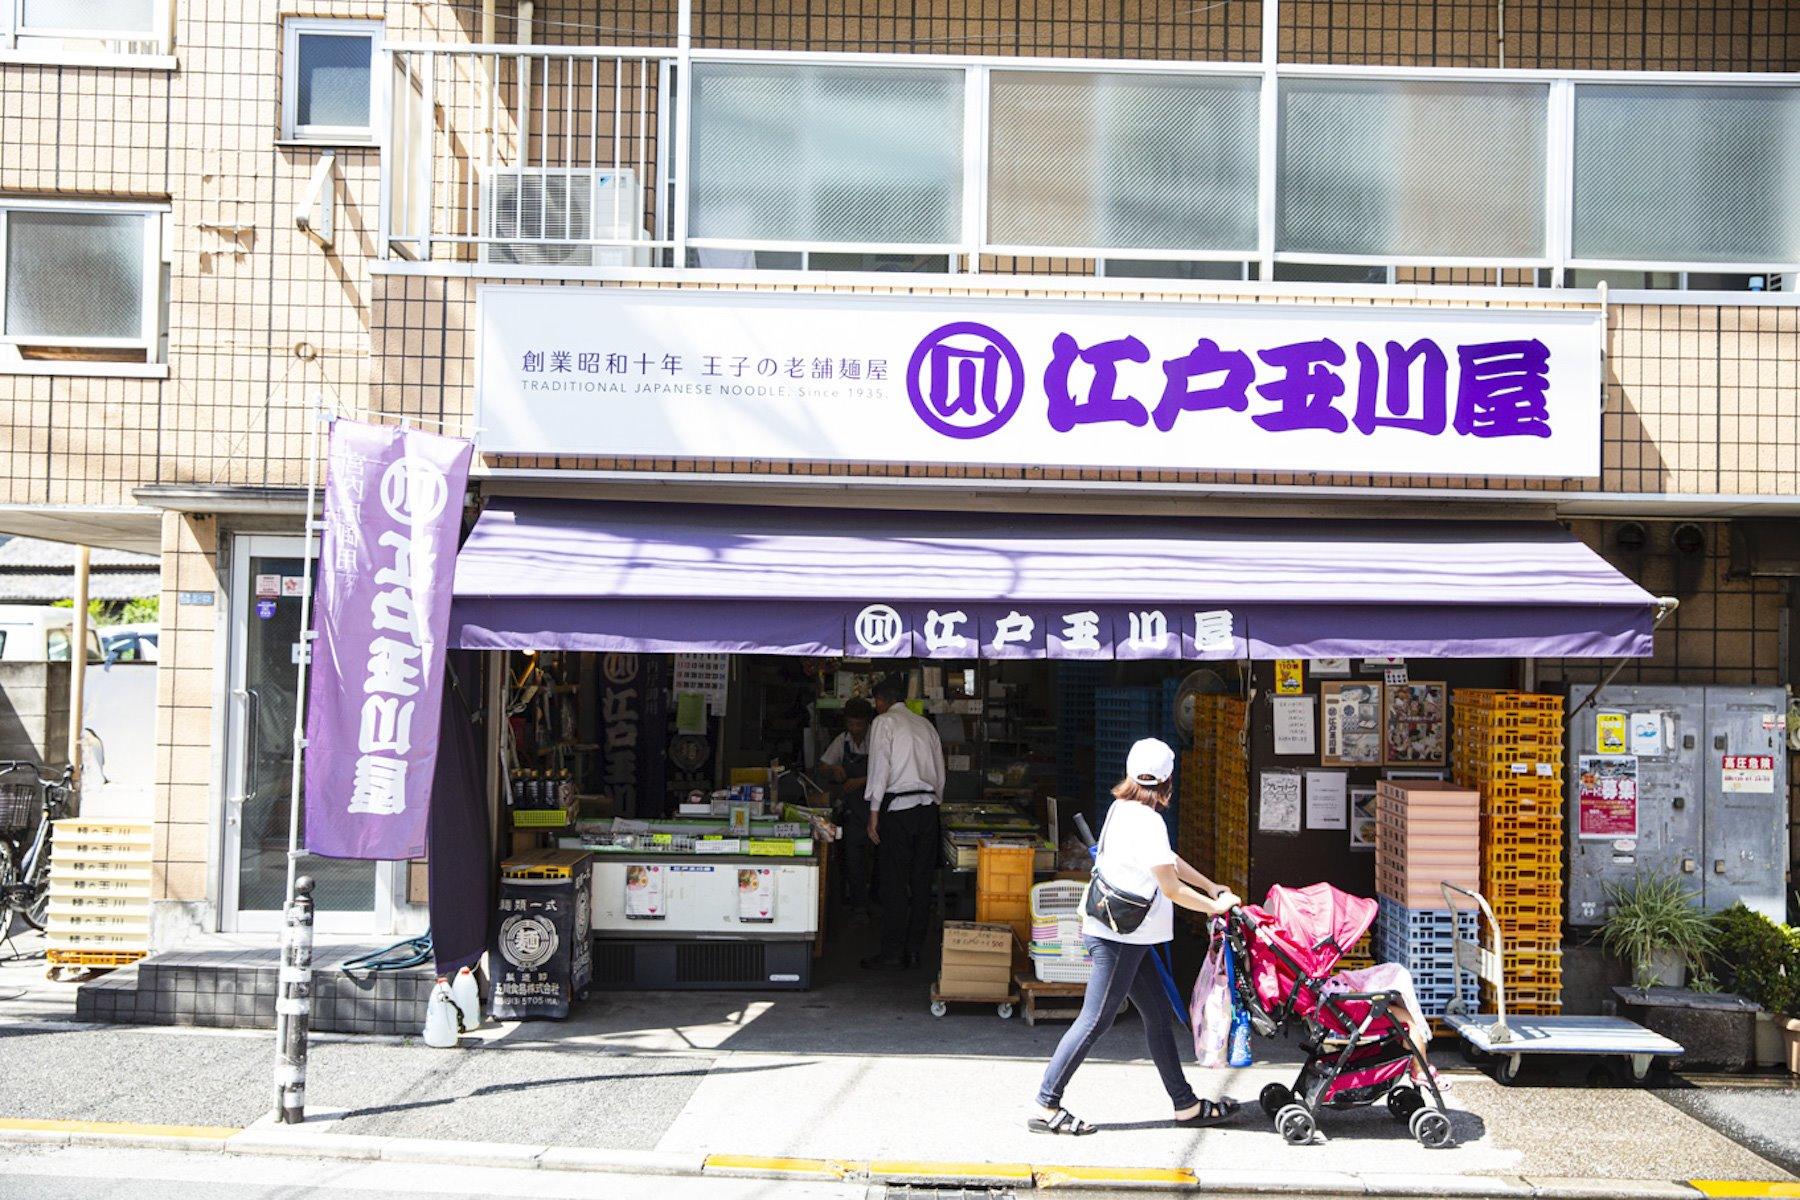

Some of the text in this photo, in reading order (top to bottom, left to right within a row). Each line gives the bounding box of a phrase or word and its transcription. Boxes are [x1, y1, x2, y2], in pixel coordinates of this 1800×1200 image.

[522, 349, 889, 381] 創業昭和十年 王子の老舗麺屋
[521, 380, 627, 394] TRADITIONAL
[634, 383, 713, 395] JAPANESE
[1043, 331, 1553, 439] 江戸玉川屋
[924, 608, 1237, 652] 江戸玉川屋
